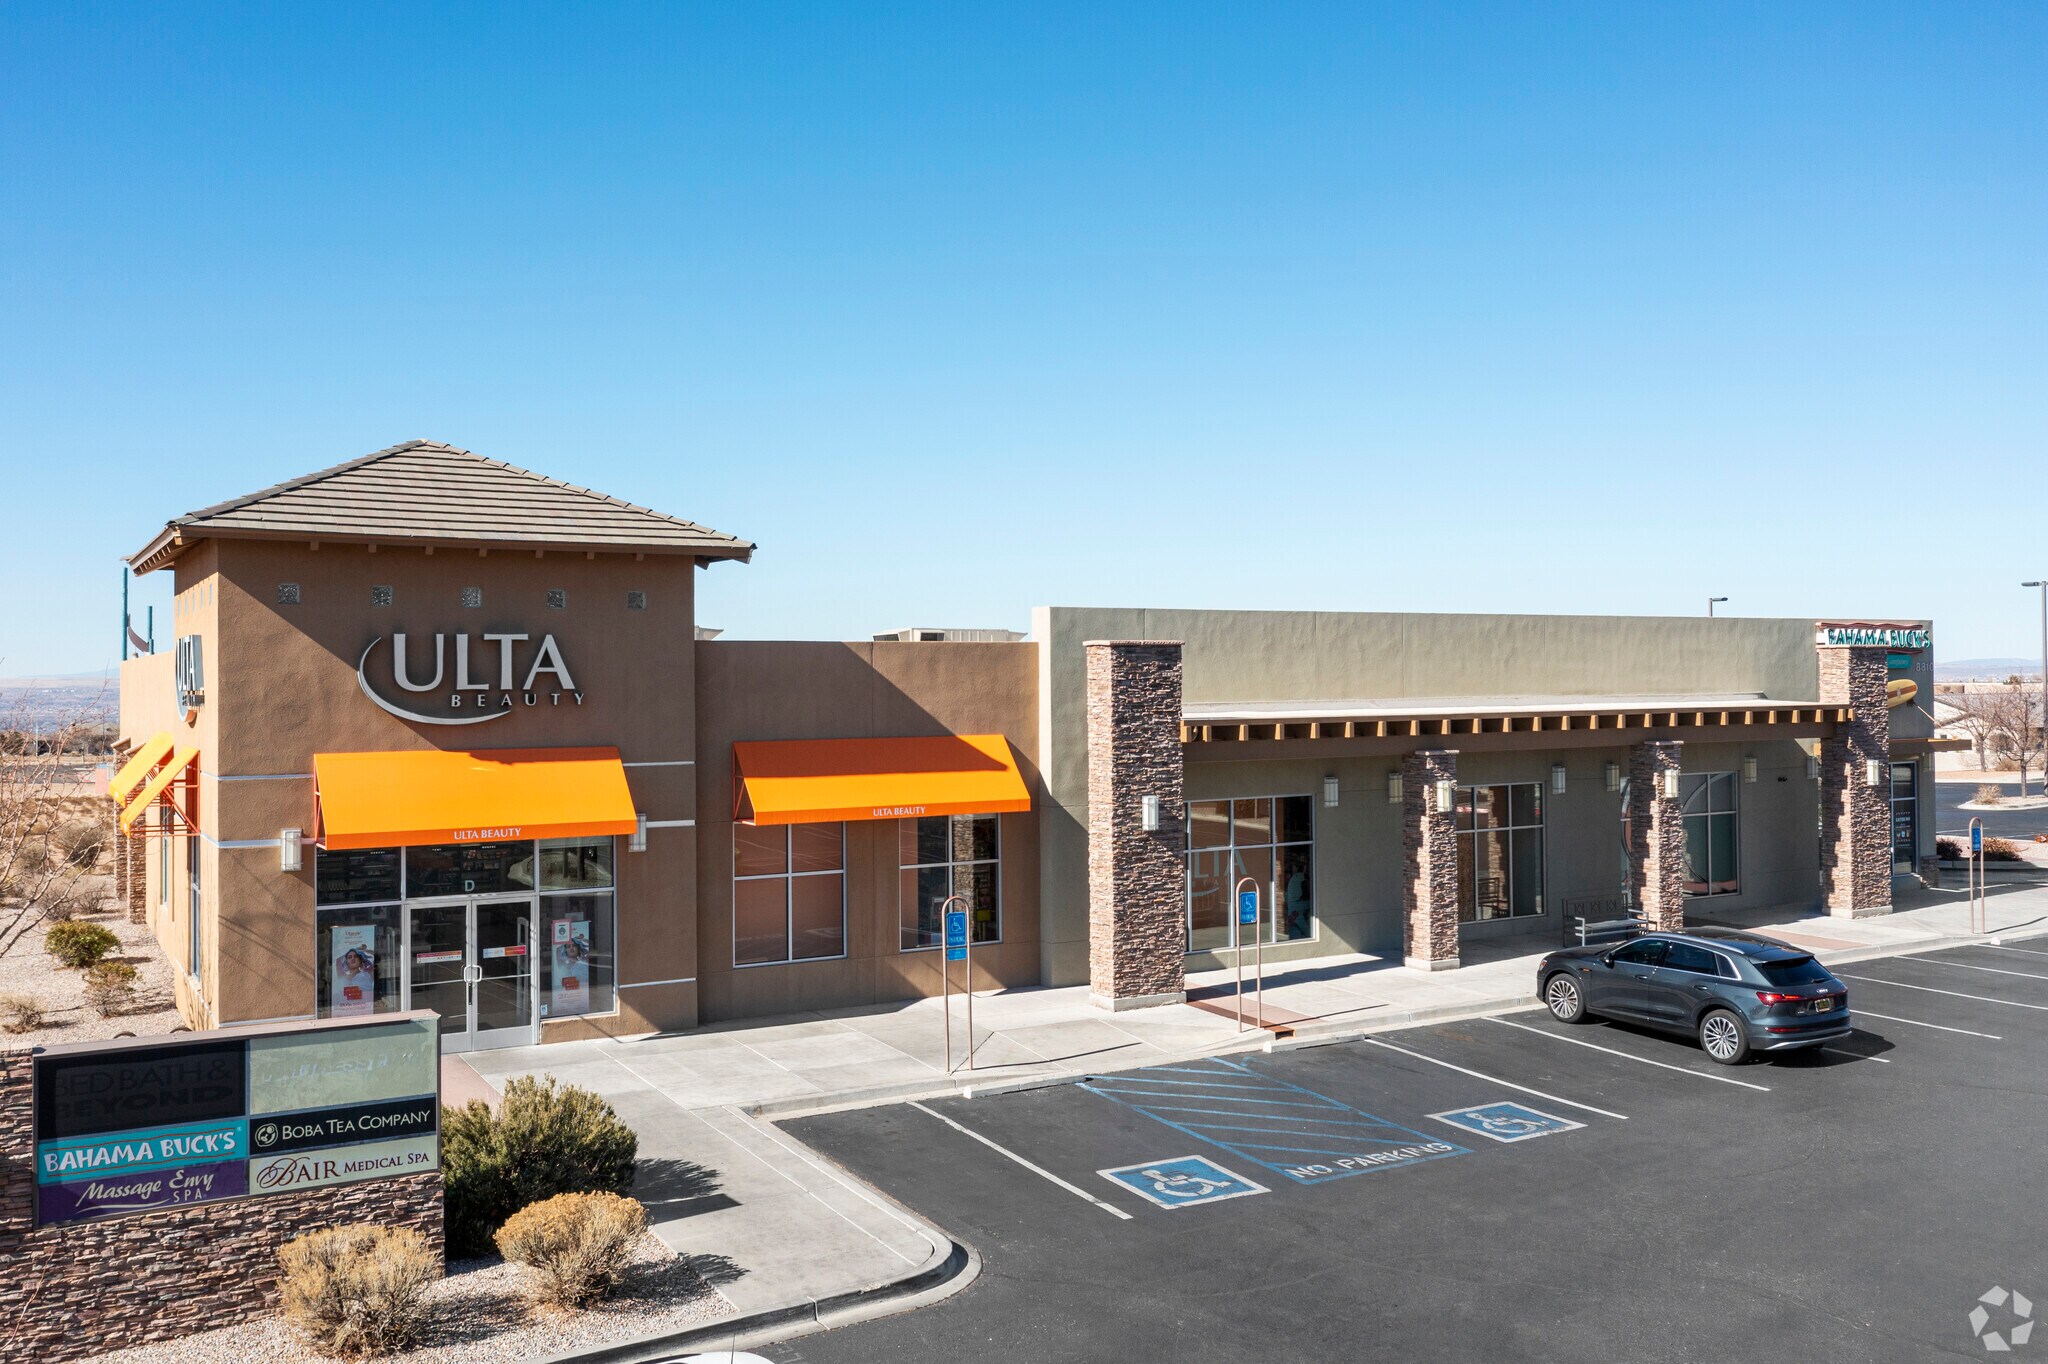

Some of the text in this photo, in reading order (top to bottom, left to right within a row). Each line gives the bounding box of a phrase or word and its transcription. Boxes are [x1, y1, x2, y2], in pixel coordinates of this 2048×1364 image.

[1825, 628, 1887, 646] BAHAMA
[393, 633, 576, 692] ULTA
[451, 693, 585, 708] BEAUTY
[873, 806, 926, 817] ULTA BEAUTY
[454, 827, 521, 840] ULTA BEAUTY
[464, 880, 475, 892] D
[55, 1058, 232, 1097] BED BATH &
[282, 1110, 431, 1140] BOBA TEA COMPANY
[43, 1131, 236, 1172] BAHAMA BUCK'S
[1284, 1142, 1453, 1178] NO PARKING
[256, 1152, 430, 1189] BAIR MEDICAL SPA
[75, 1169, 215, 1208] Massage Envy
[173, 1188, 203, 1203] SPA
